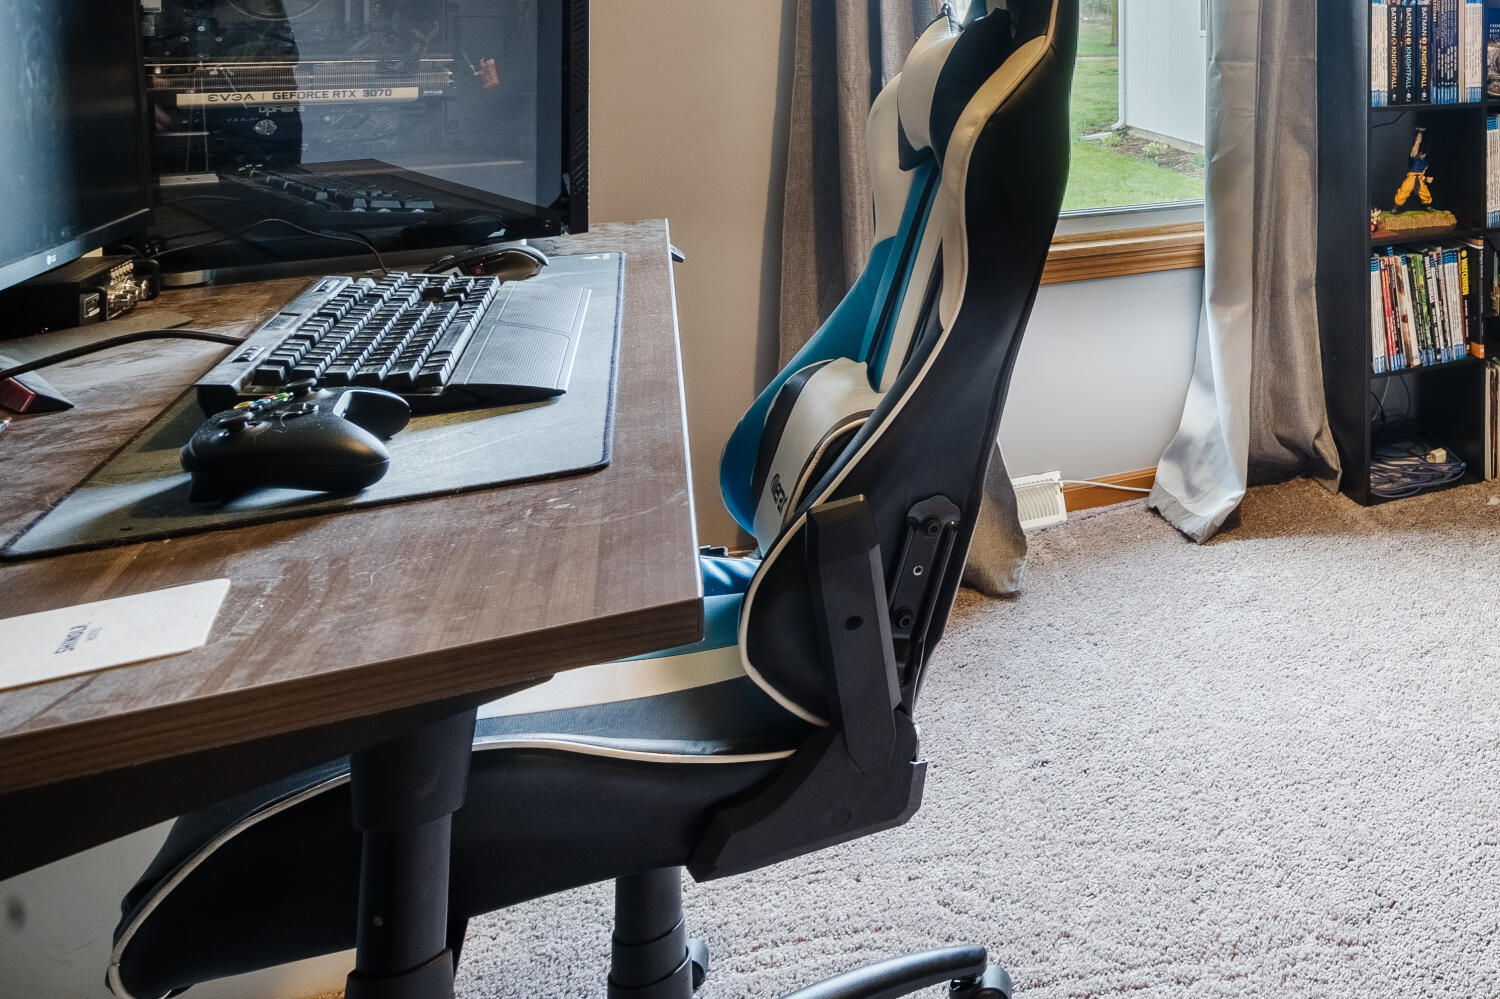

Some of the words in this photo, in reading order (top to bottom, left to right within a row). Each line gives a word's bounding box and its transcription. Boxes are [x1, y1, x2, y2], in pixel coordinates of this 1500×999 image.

[207, 93, 256, 102] EVGA
[272, 91, 329, 100] GEFORCE
[332, 90, 356, 99] RTX
[362, 88, 392, 98] 3070
[1461, 258, 1469, 295] WATCHMEN
